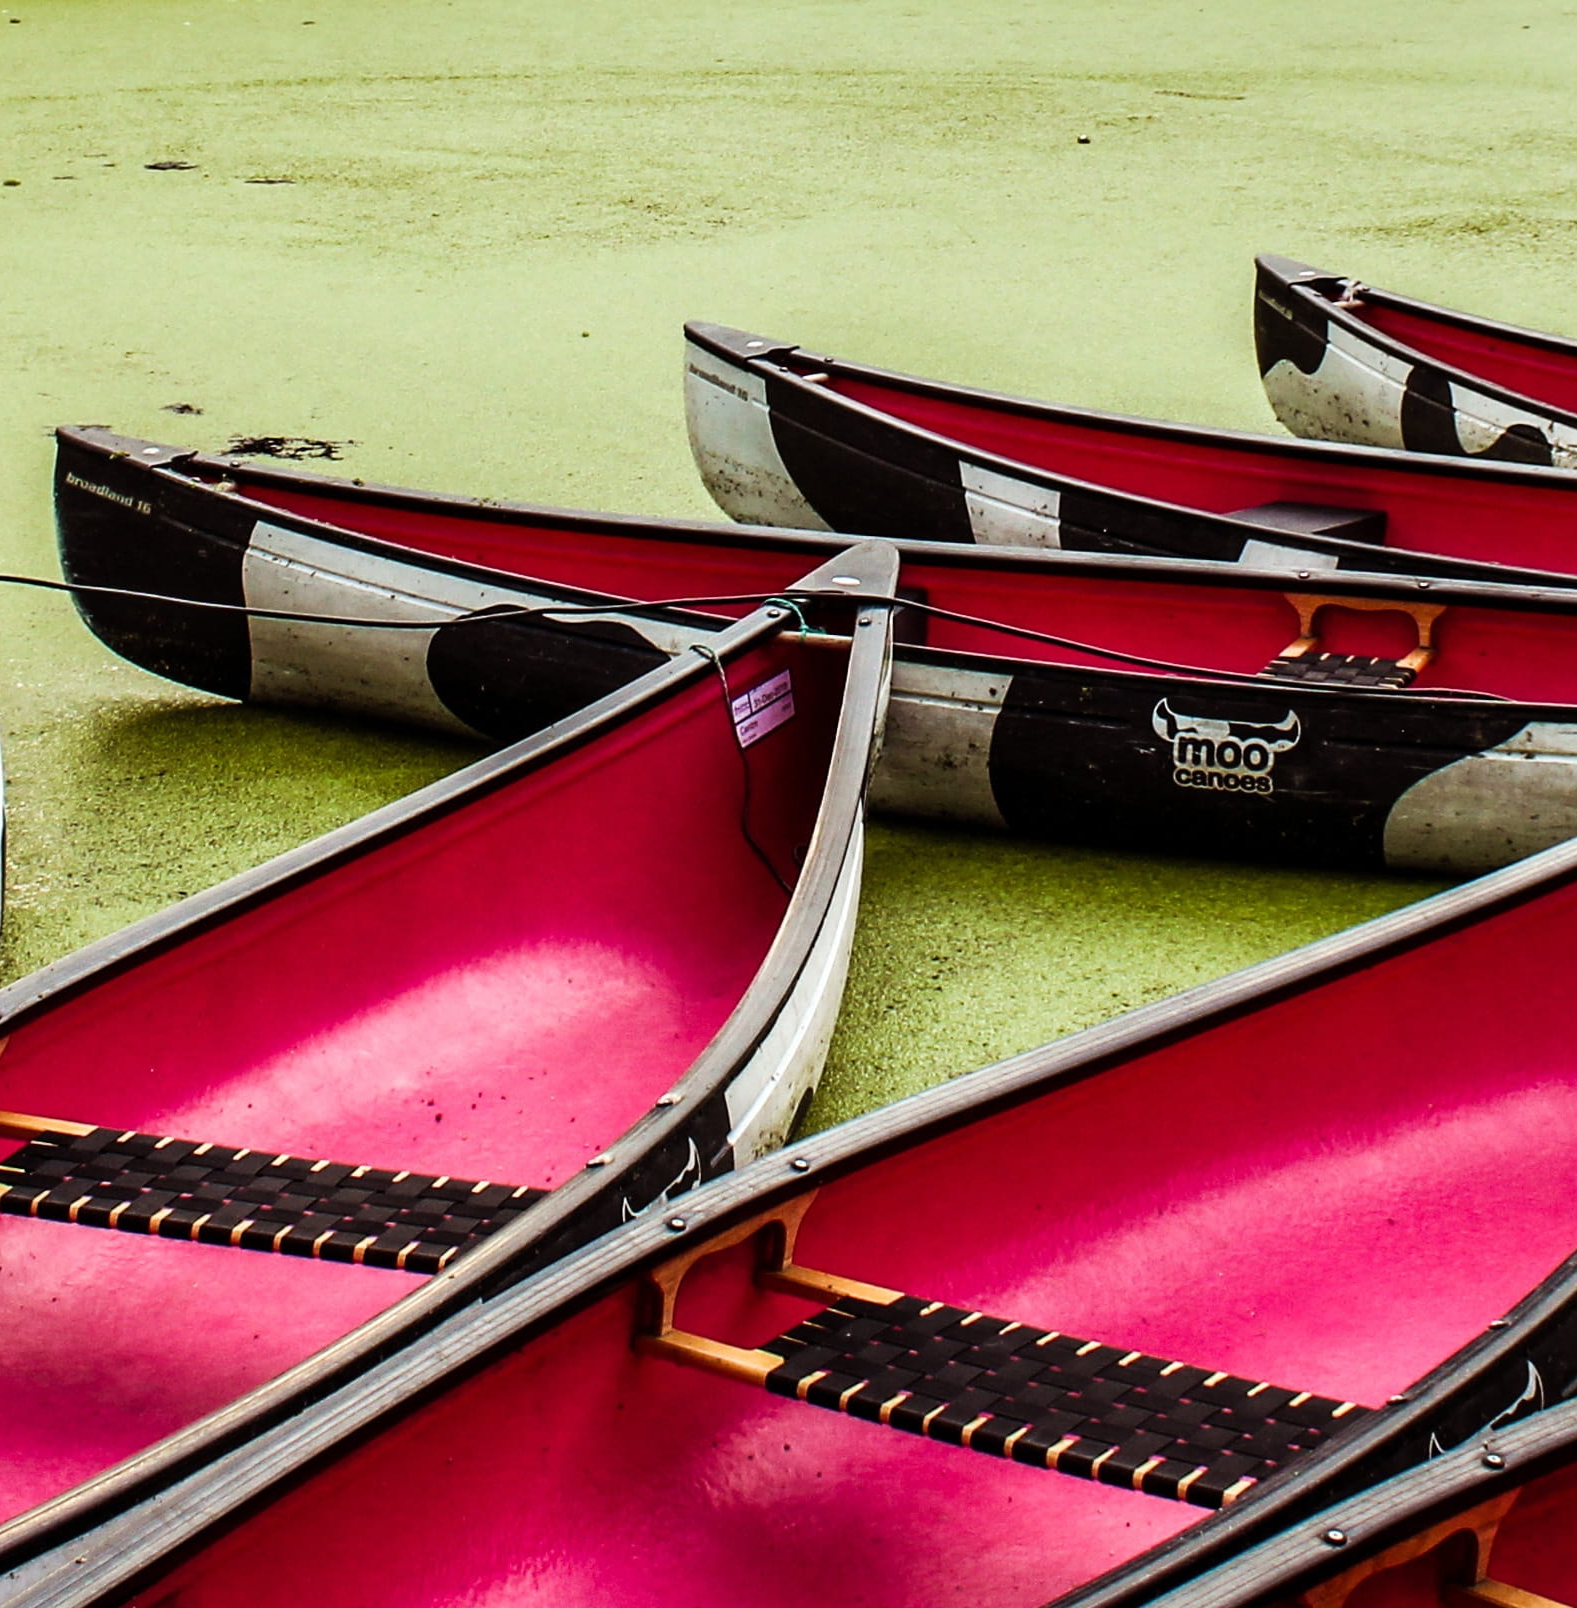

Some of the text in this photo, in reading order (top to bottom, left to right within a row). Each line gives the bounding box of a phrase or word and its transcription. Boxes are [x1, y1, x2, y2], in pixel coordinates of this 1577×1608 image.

[66, 472, 151, 514] broadland 16
[1177, 735, 1270, 772] moo
[1174, 767, 1272, 793] canoes
